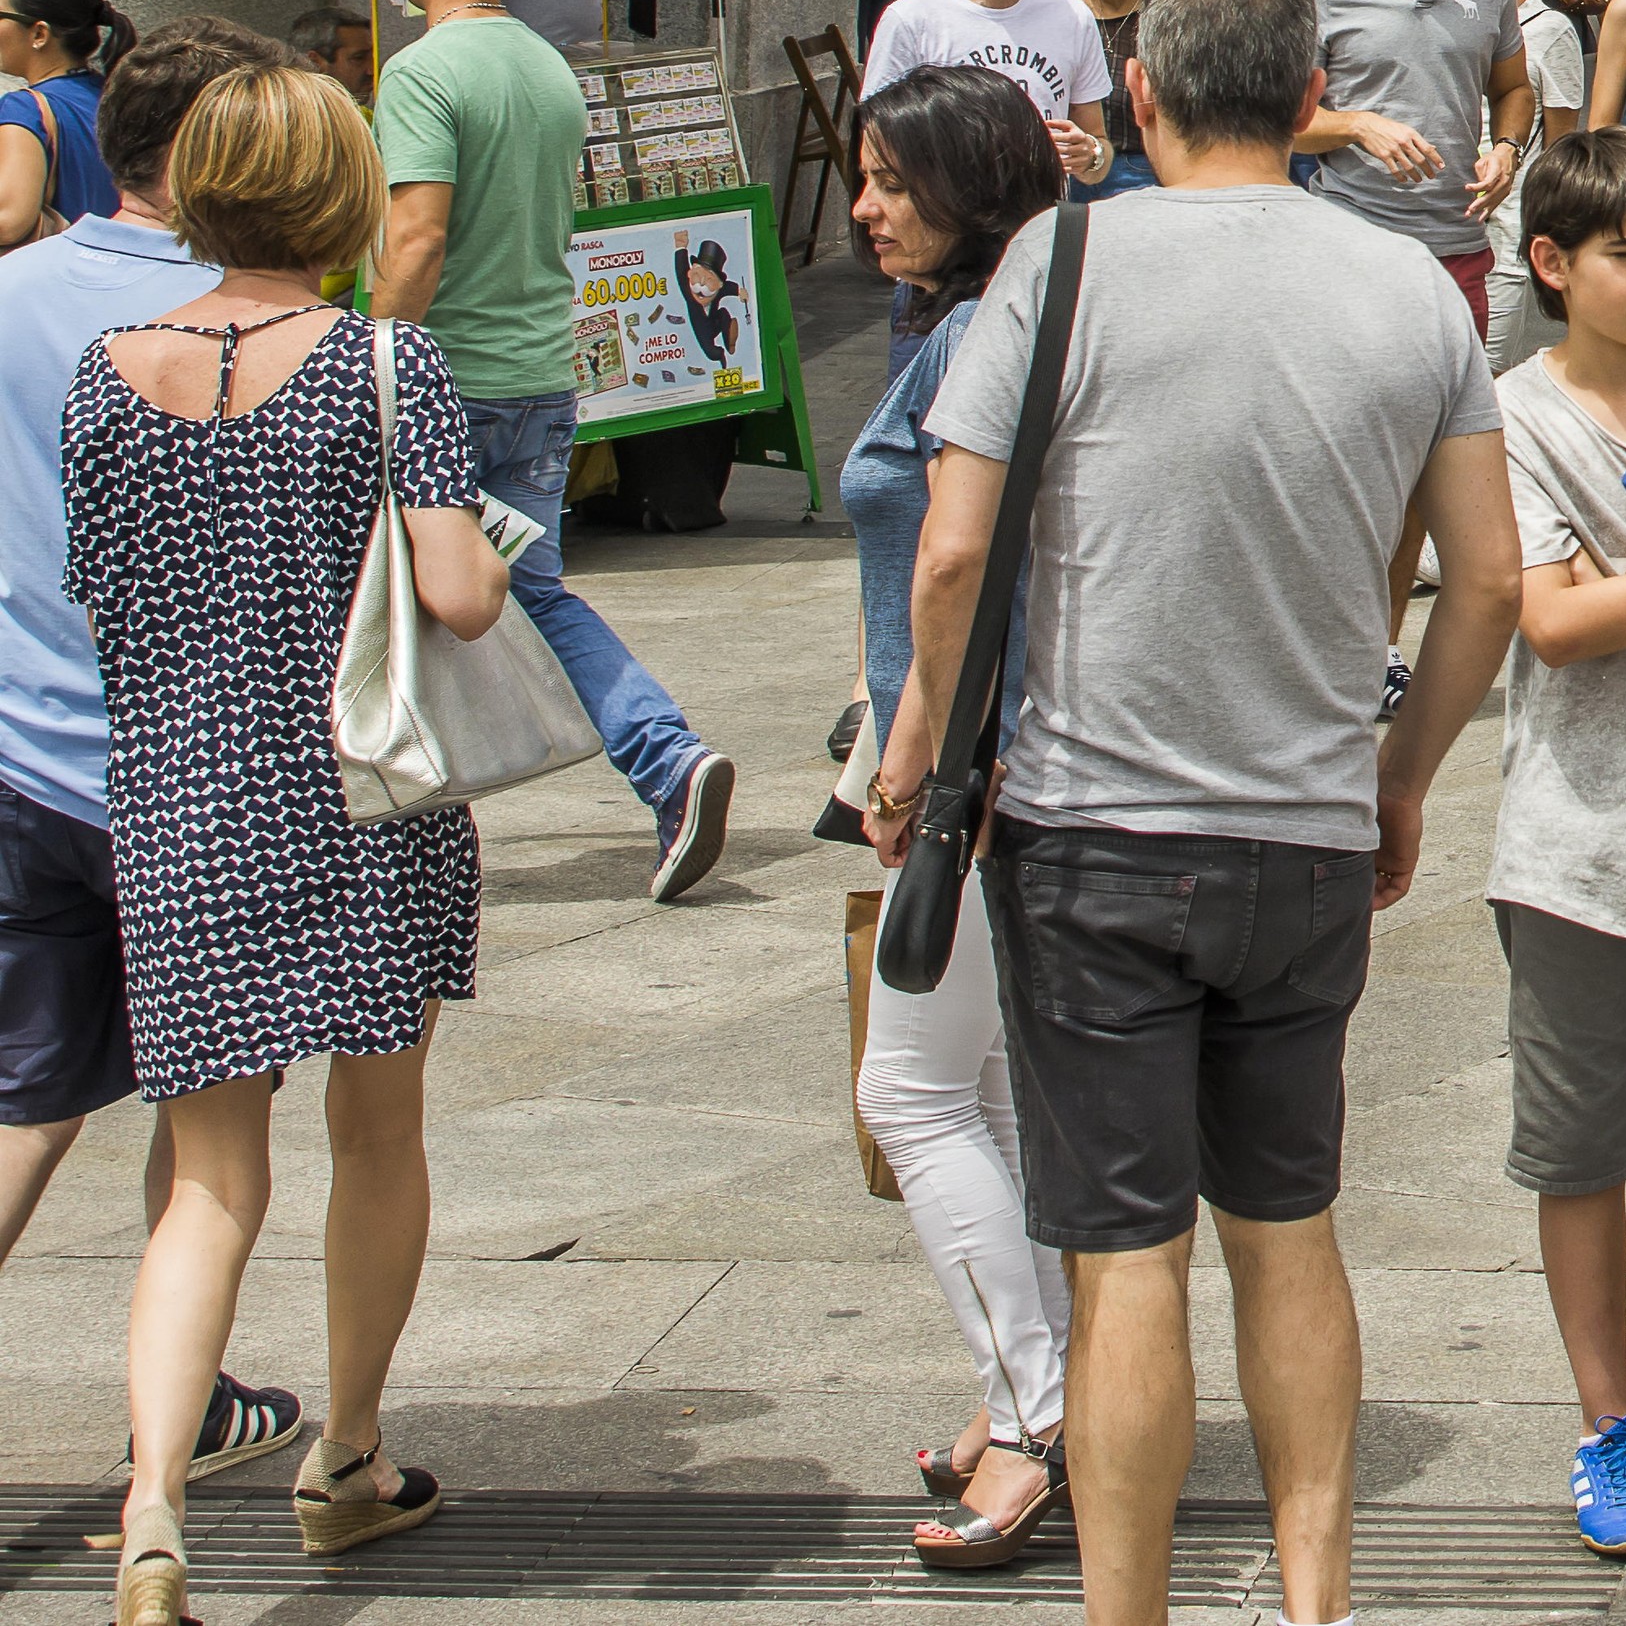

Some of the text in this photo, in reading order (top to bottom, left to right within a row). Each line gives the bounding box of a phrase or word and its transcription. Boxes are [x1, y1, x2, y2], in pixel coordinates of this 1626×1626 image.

[969, 45, 1065, 102] RCROMBIE
[580, 240, 604, 252] RASCA
[590, 251, 644, 271] MONOPOLY
[582, 271, 668, 307] 60.000€
[644, 333, 678, 352] ¡ME LO
[639, 346, 686, 365] COMPRO!
